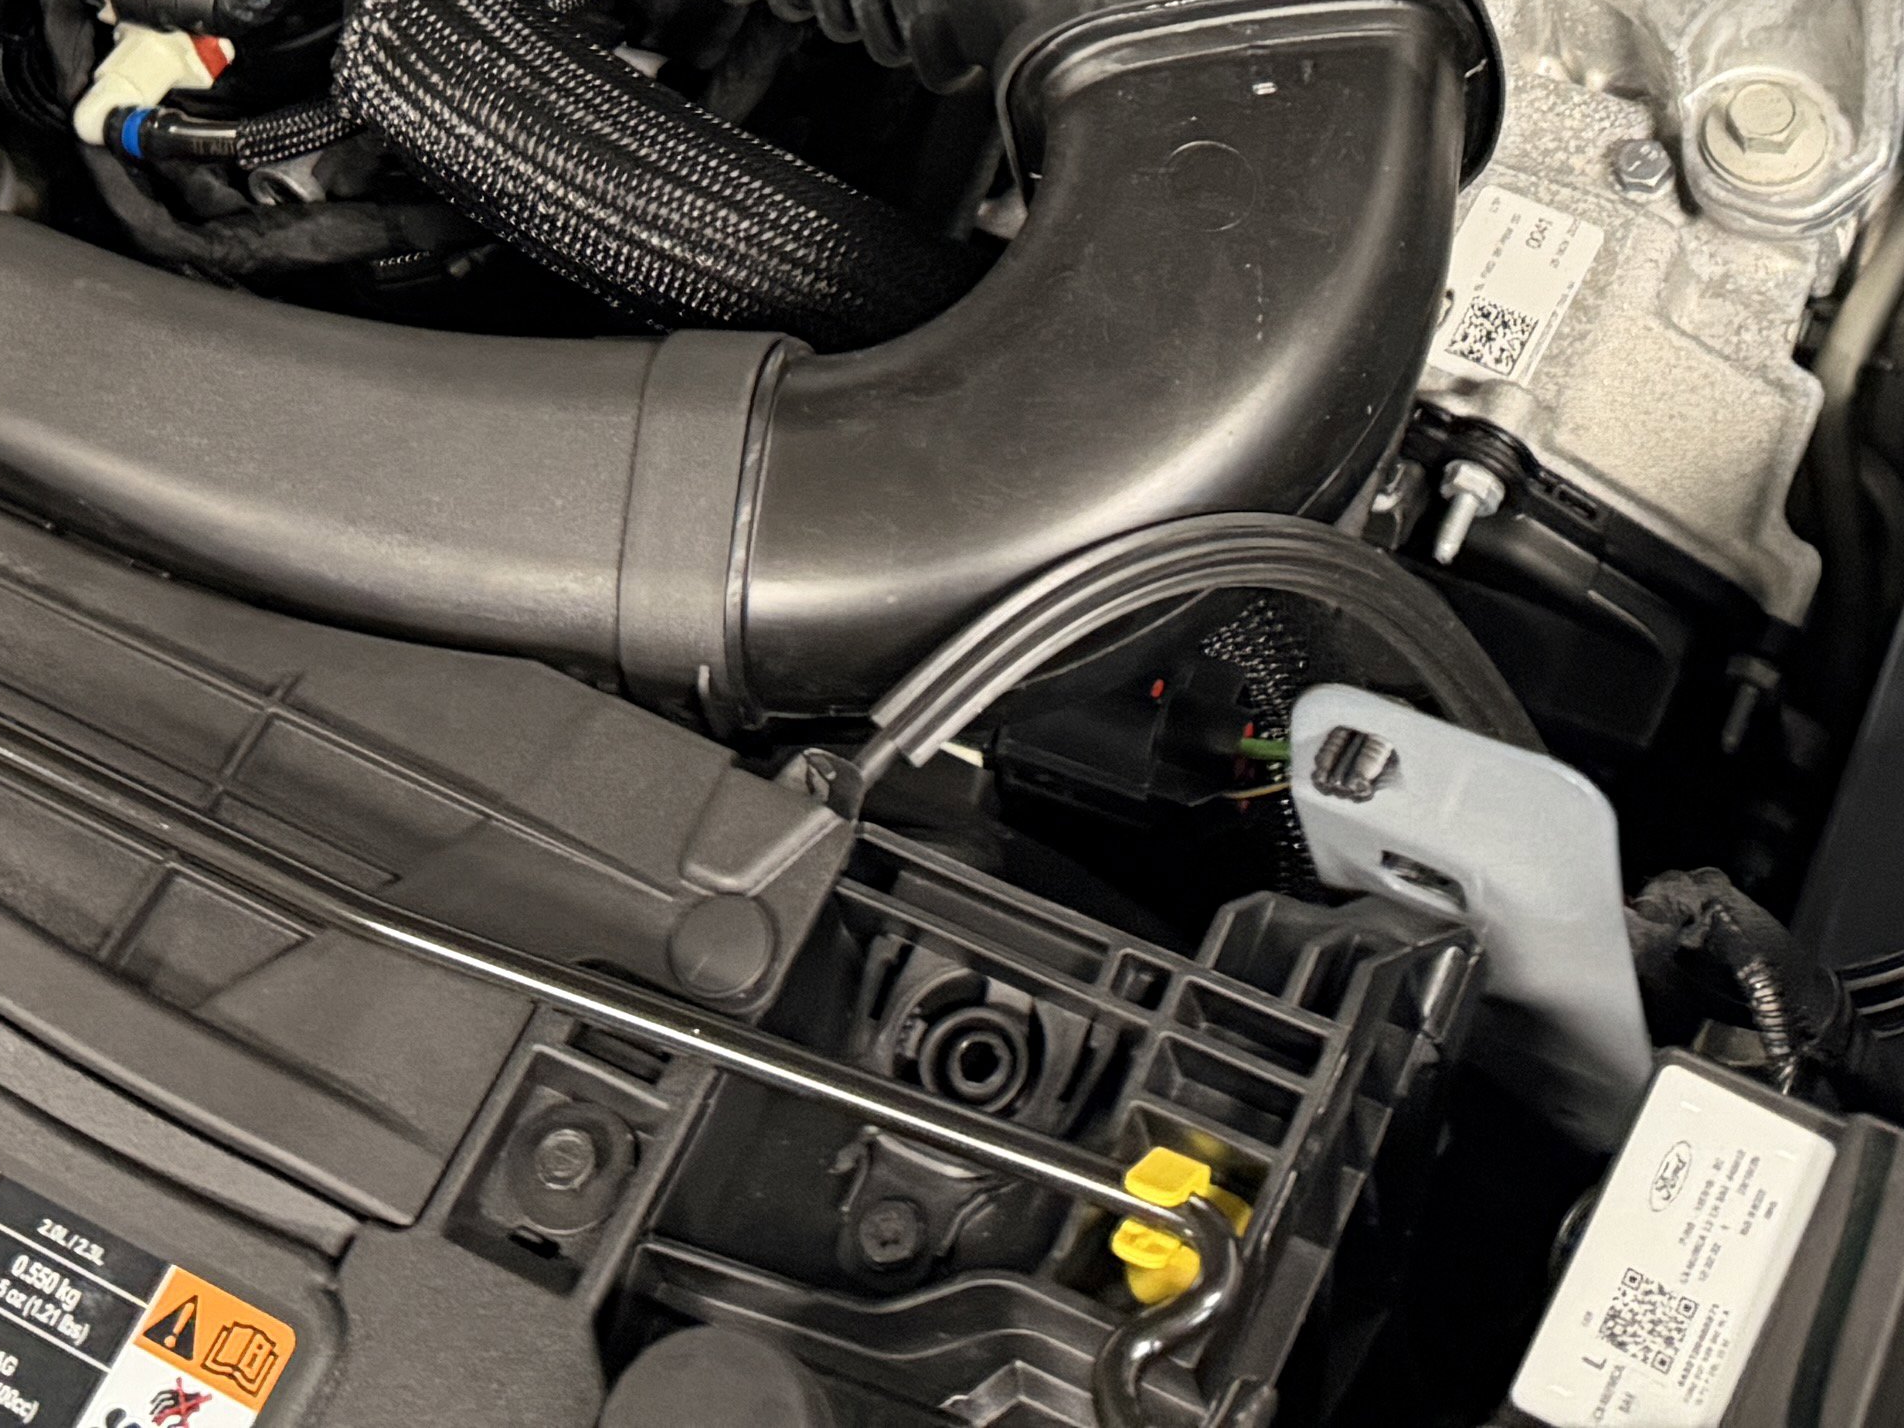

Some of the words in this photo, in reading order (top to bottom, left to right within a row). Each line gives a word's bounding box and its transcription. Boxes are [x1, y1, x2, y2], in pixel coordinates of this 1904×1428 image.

[10, 1254, 61, 1295] 0.550
[50, 1277, 83, 1312] kg
[5, 1288, 28, 1309] oz
[56, 1313, 90, 1346] lbs)
[1579, 1349, 1607, 1371] L
